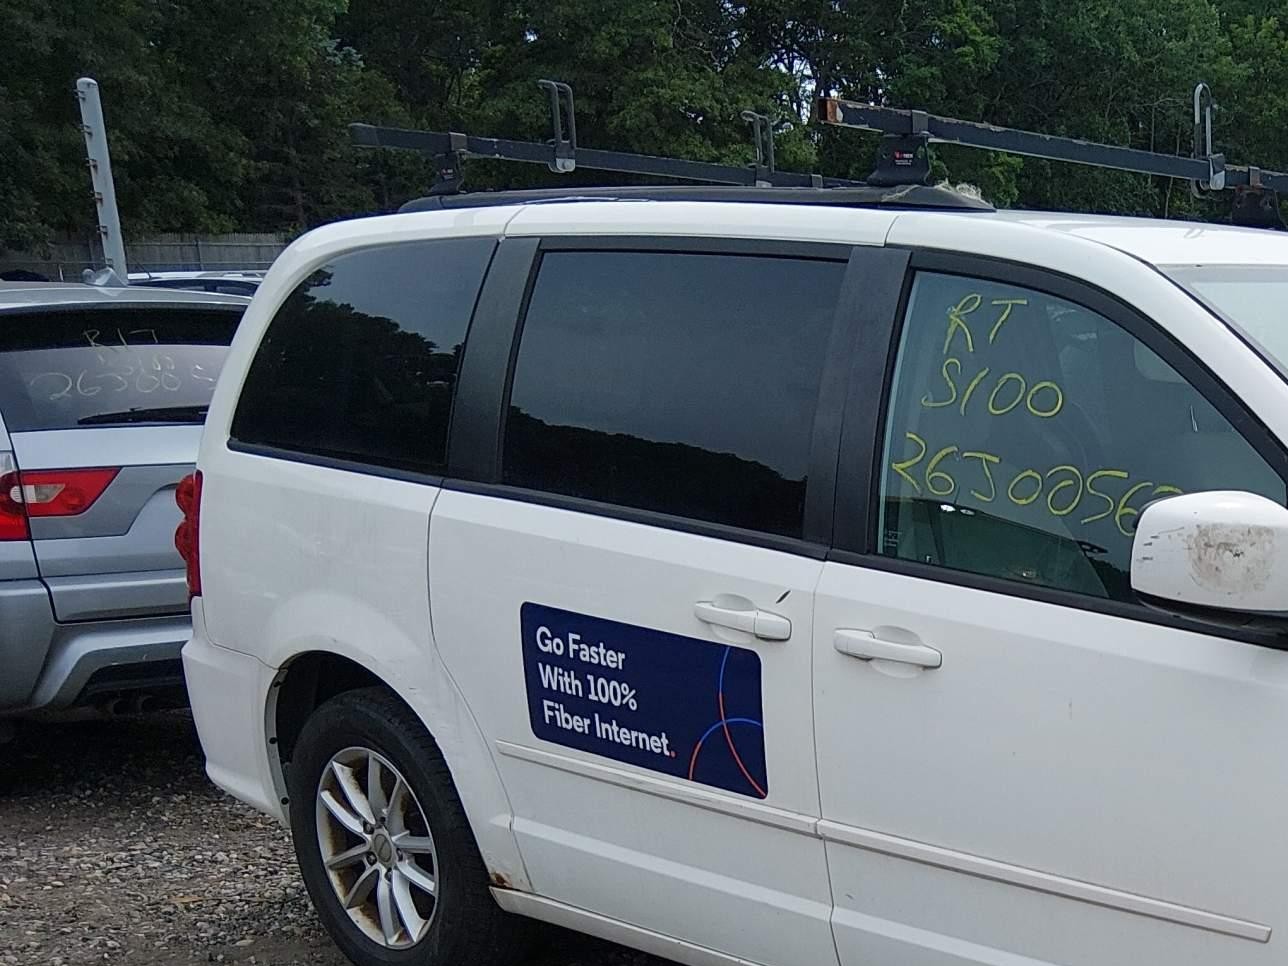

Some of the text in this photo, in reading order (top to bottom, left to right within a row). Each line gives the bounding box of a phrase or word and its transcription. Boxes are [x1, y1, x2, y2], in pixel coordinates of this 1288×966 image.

[920, 357, 1064, 417] S100
[535, 625, 626, 671] Go Faster
[537, 661, 638, 711] With 100%
[543, 699, 676, 758] Fiber Internet.
